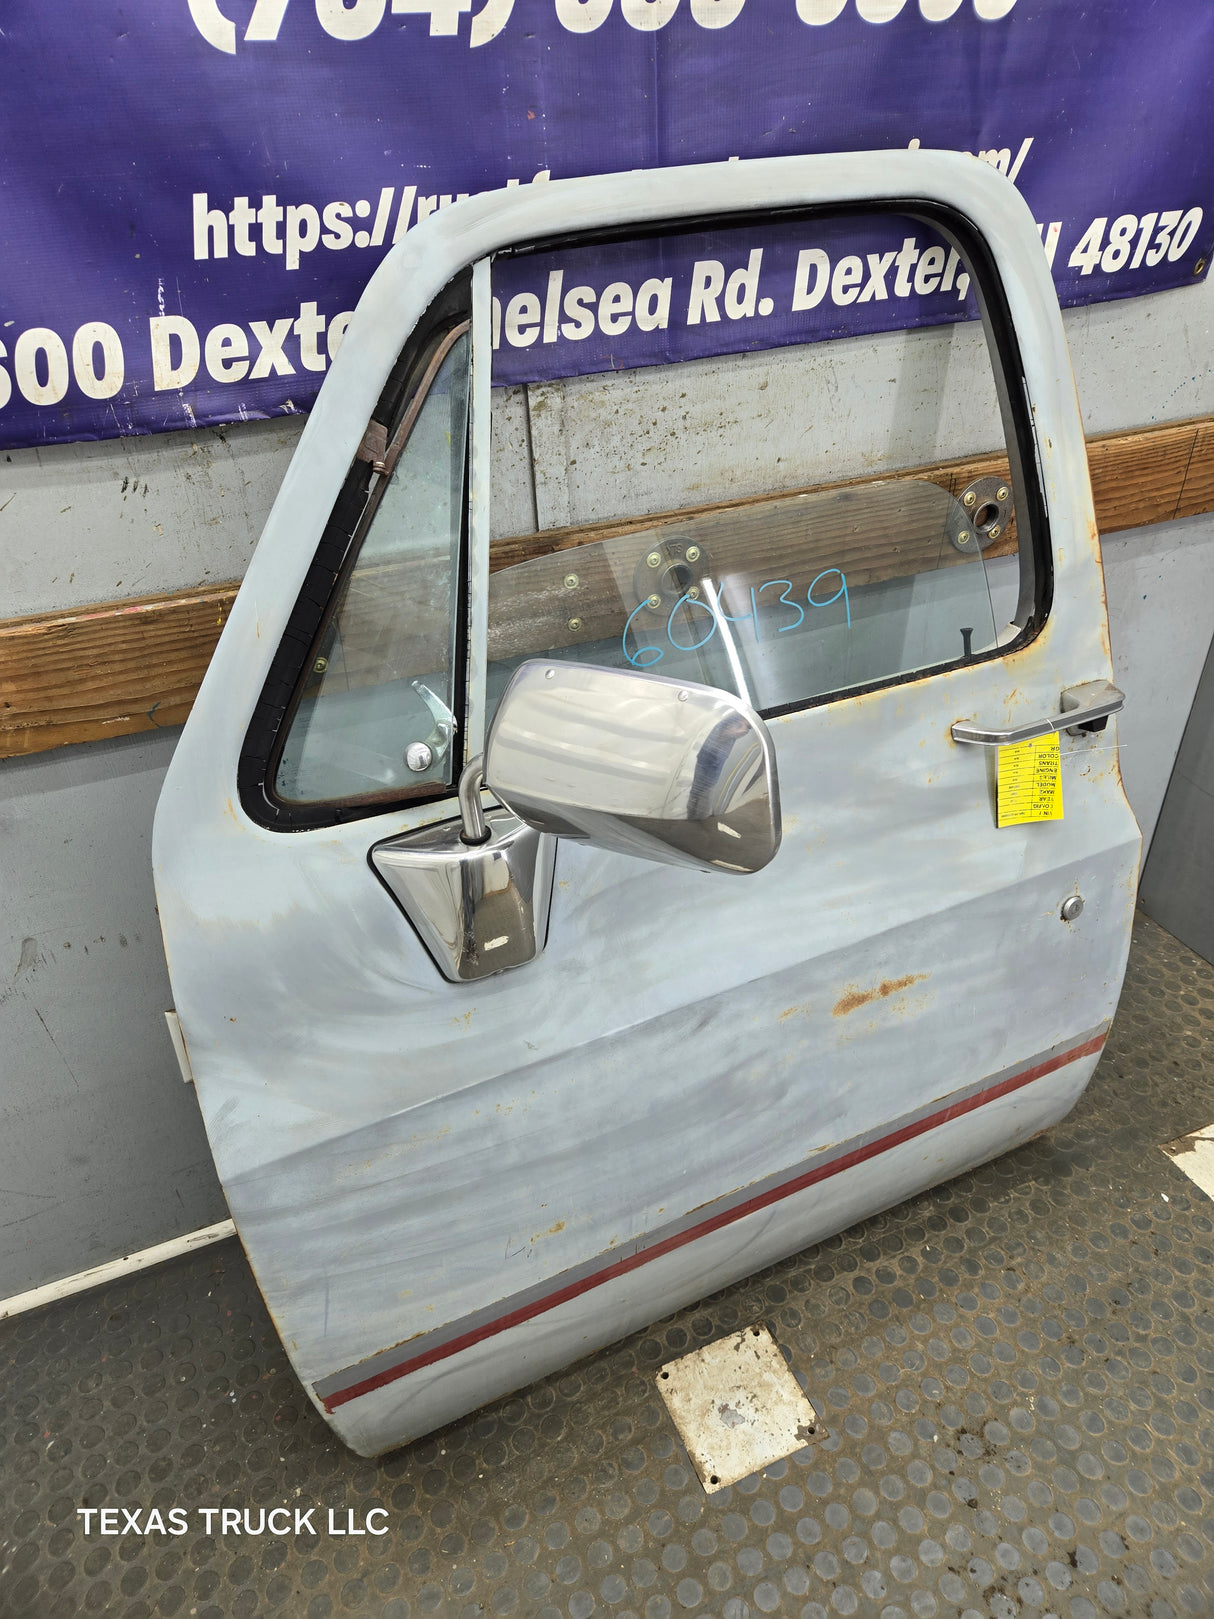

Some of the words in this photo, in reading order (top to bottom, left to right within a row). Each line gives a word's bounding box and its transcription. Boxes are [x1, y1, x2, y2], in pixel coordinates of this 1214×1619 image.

[0, 321, 124, 410] 00
[687, 248, 774, 325] Rd.
[1067, 207, 1203, 276] 48130
[623, 568, 851, 667] 60439
